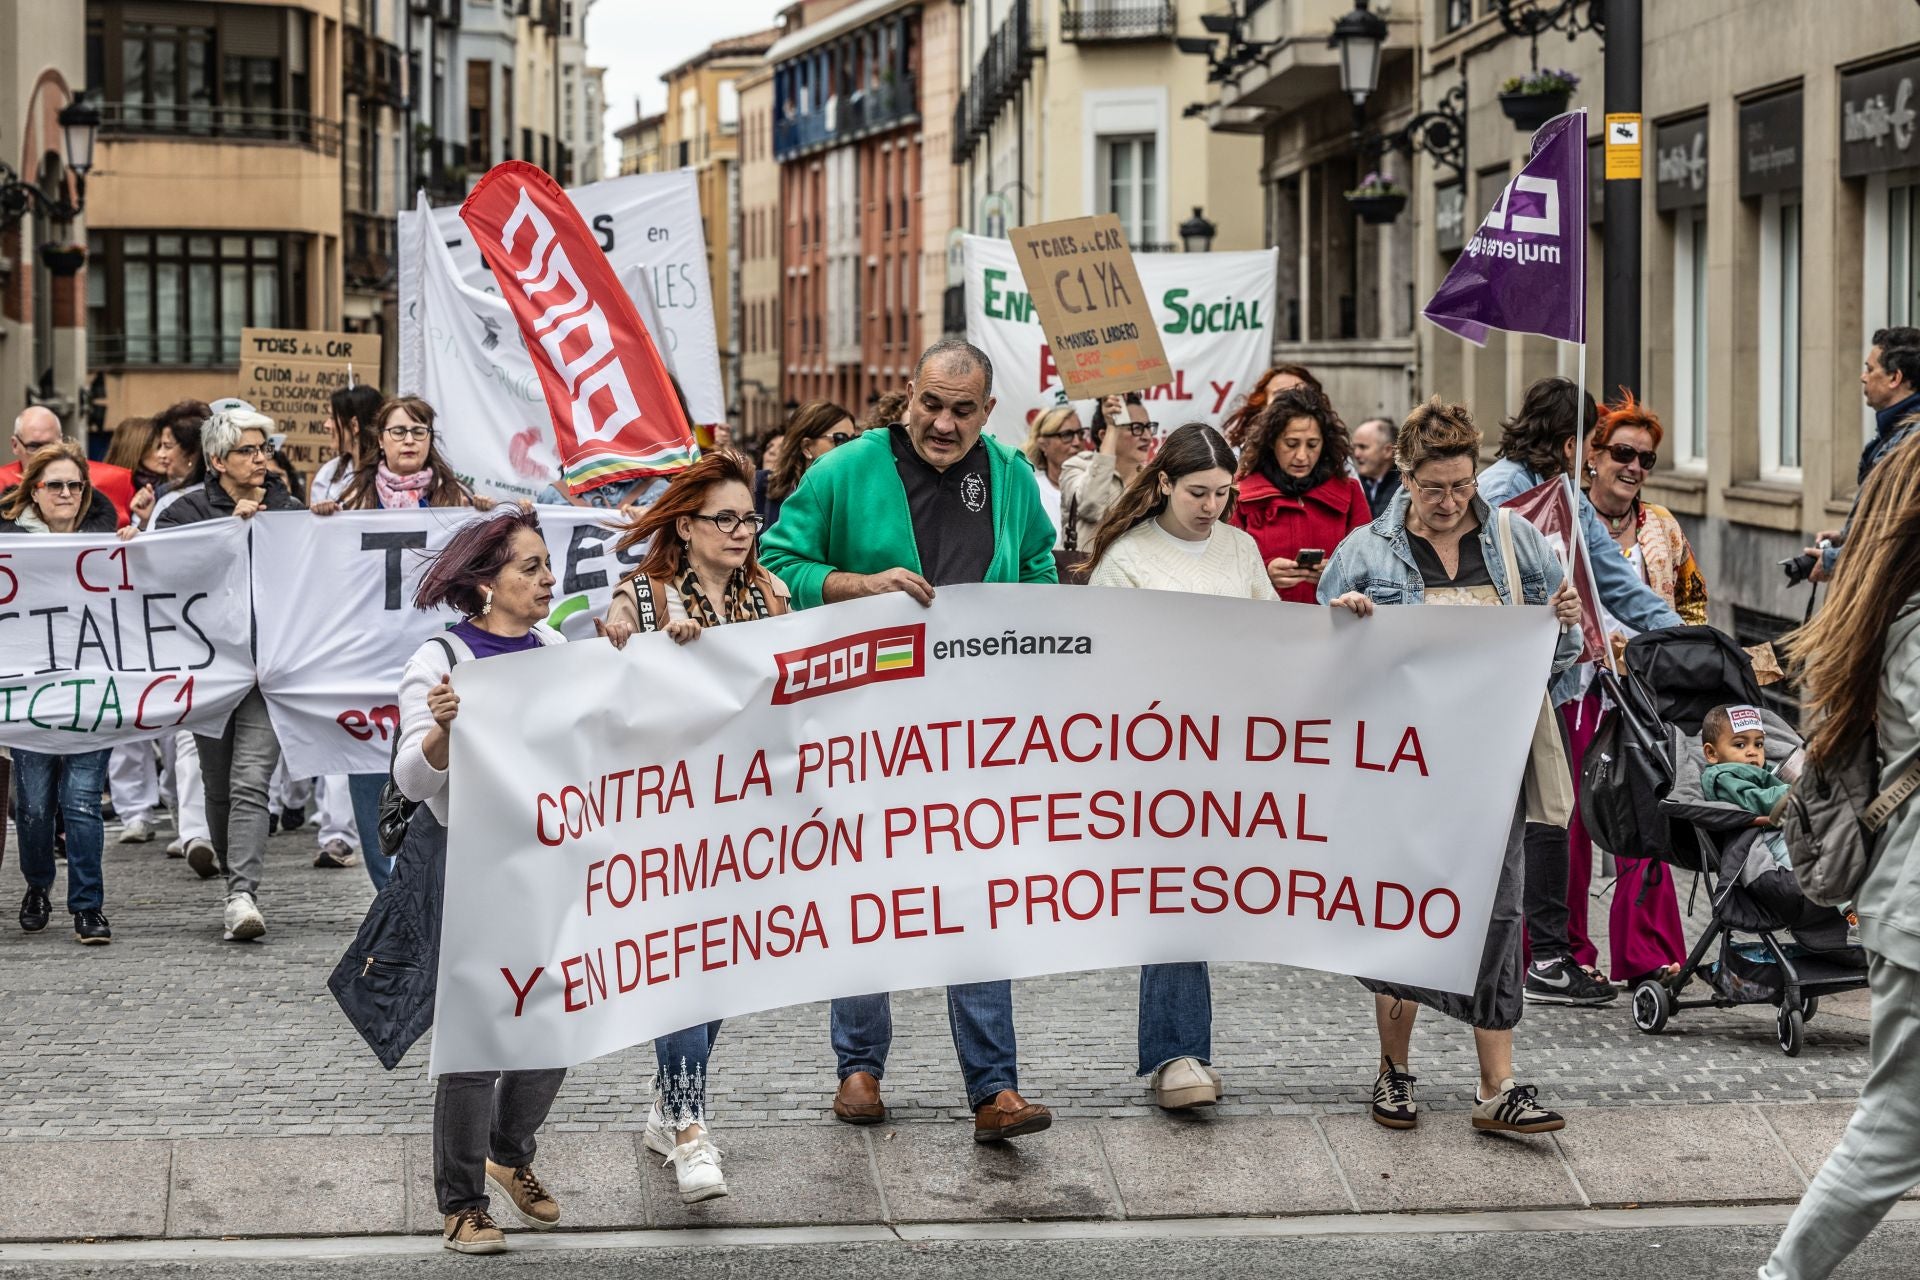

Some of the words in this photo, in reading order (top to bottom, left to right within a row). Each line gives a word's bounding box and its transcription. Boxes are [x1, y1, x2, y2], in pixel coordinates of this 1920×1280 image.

[1094, 228, 1122, 250] CAR
[1055, 267, 1097, 314] C1
[1093, 262, 1131, 308] YA
[326, 341, 352, 357] CAR
[495, 481, 533, 496] MAYORES
[76, 547, 134, 592] C1
[784, 641, 869, 695] CCOO
[932, 630, 1093, 661] enseñanza
[537, 760, 695, 847] CONTRA
[715, 749, 772, 804] LA
[797, 700, 1220, 795] PRIVATIZACIÓN
[1246, 716, 1331, 765] DE
[1355, 720, 1430, 777] LA
[586, 807, 864, 916] FORMACIÓN
[884, 789, 1329, 860] PROFESIONAL
[500, 967, 545, 1017] Y
[560, 947, 608, 1013] EN
[616, 900, 829, 994] DEFENSA
[850, 885, 965, 945] DEL
[987, 866, 1461, 940] PROFESORADO
